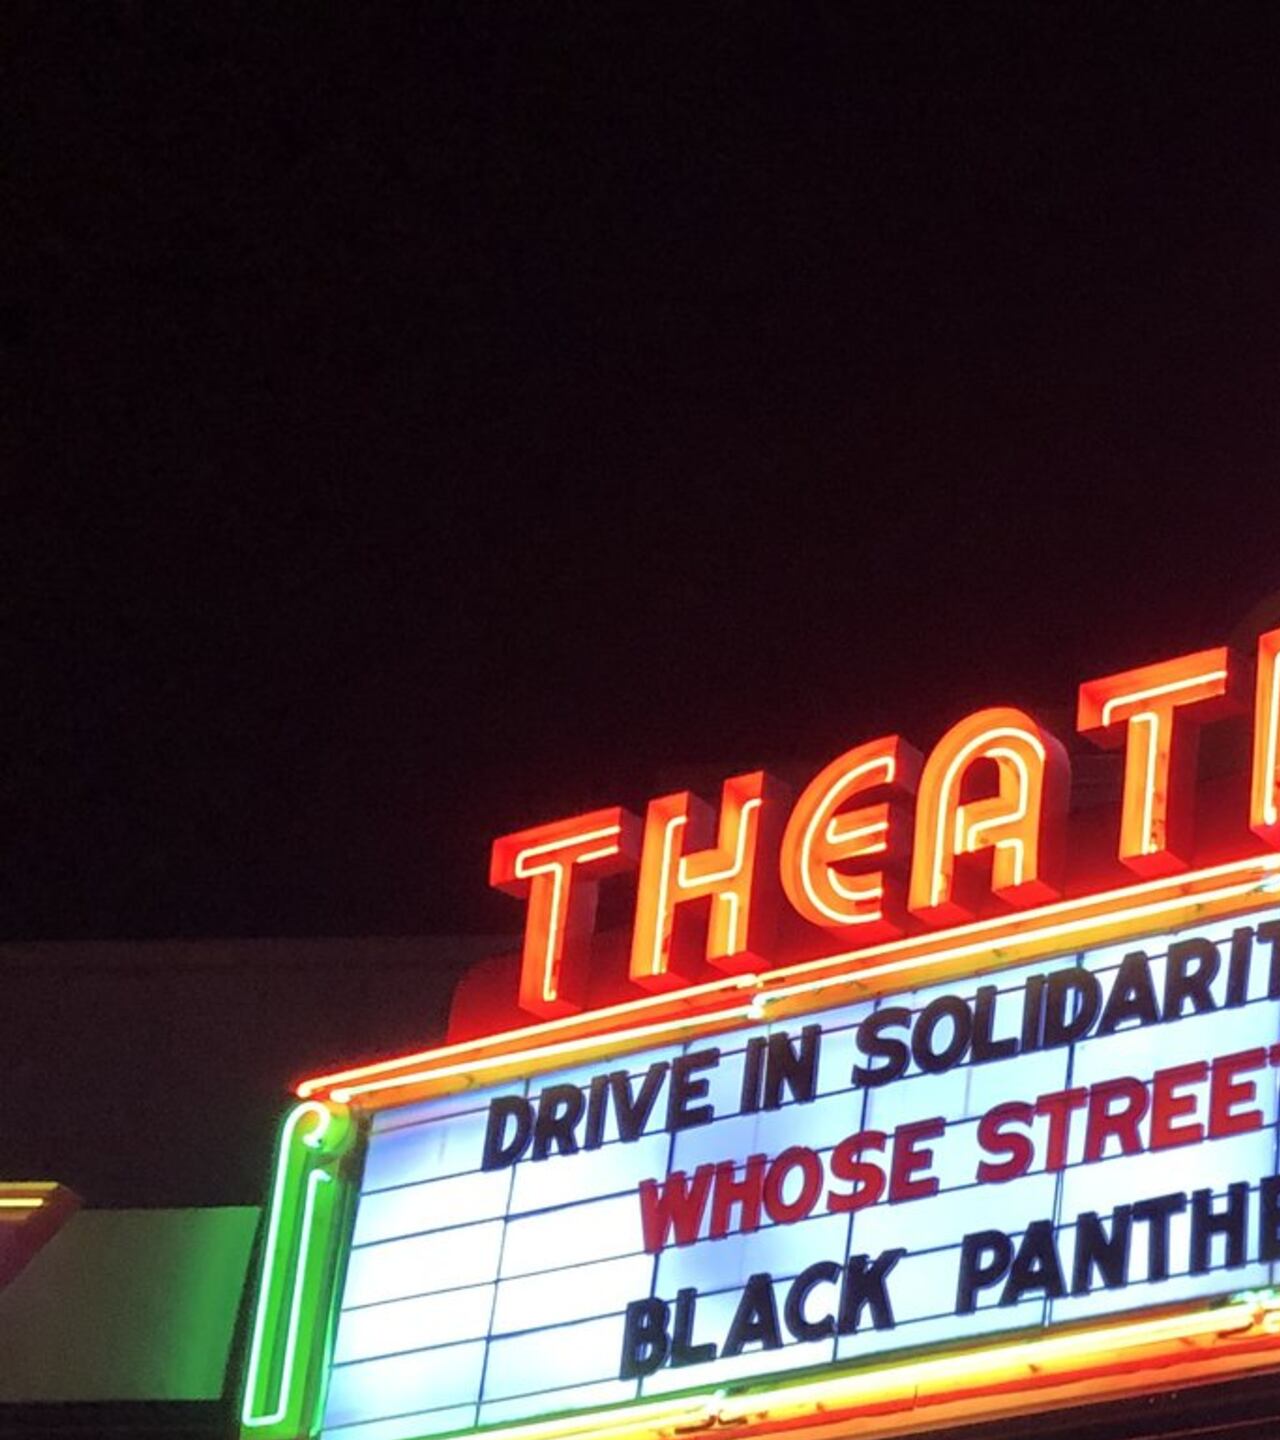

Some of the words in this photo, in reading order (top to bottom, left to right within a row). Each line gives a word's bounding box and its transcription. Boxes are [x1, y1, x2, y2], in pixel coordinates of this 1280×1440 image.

[483, 1047, 715, 1168] DRIVE
[742, 1035, 822, 1115] IN
[638, 1119, 940, 1255] WHOSE
[618, 1245, 906, 1381] BLACK
